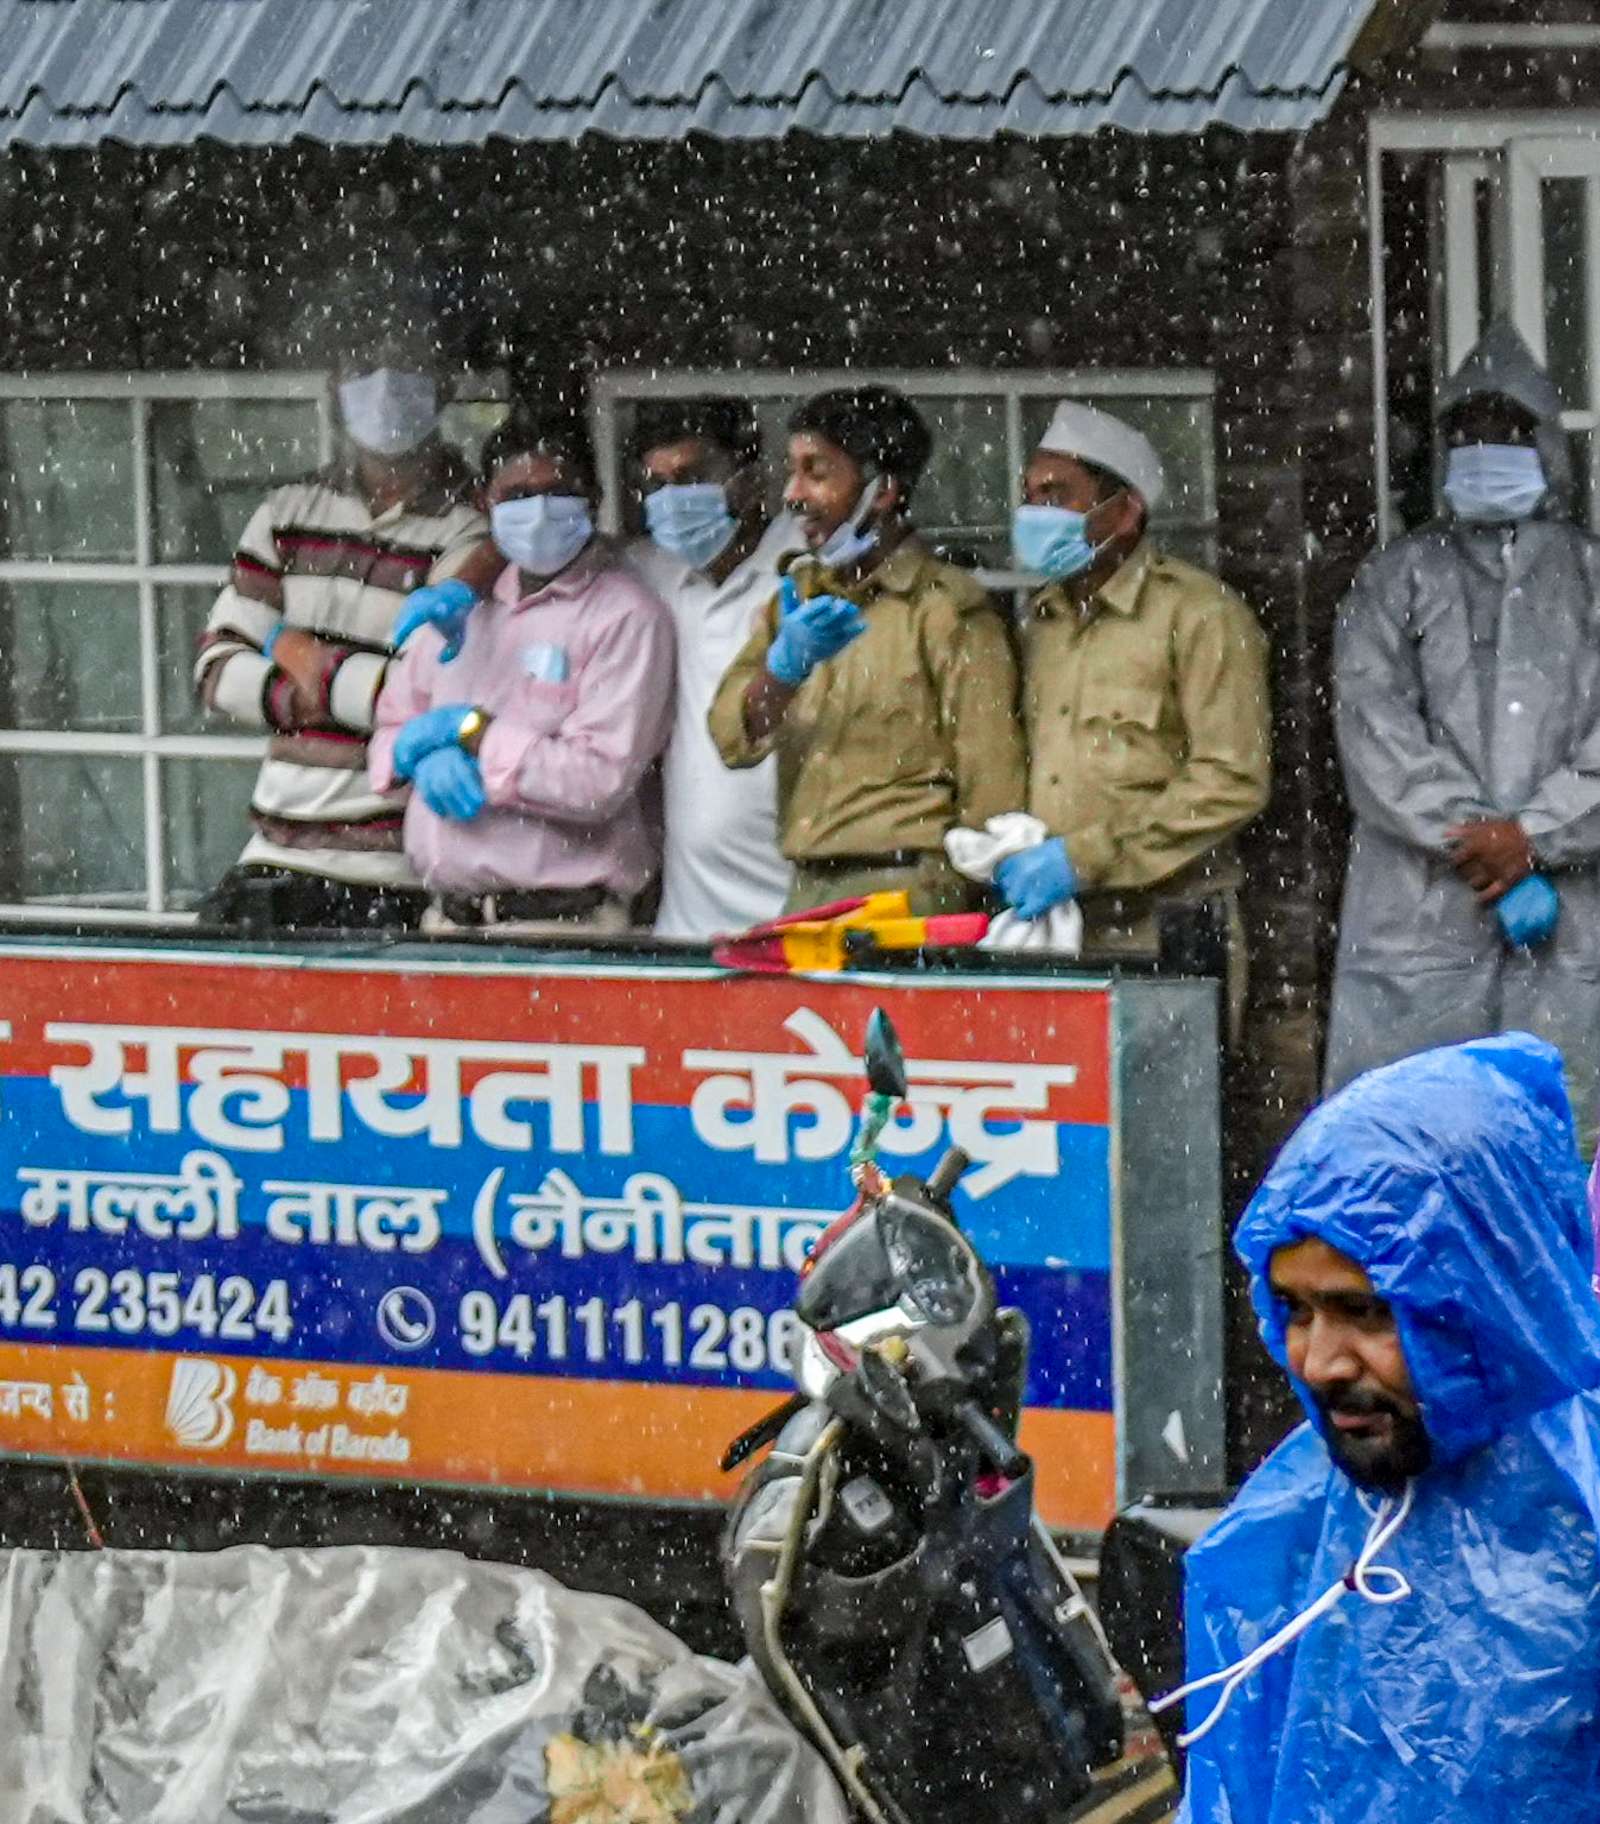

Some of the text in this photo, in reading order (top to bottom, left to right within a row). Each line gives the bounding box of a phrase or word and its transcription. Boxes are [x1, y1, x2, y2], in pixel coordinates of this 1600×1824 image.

[44, 1005, 1078, 1201] सहायता केन्द्र
[16, 1149, 244, 1241] मल्ली
[261, 1179, 448, 1256] ताल
[73, 1268, 294, 1344] 235424
[245, 1418, 411, 1463] Bank of Baroda
